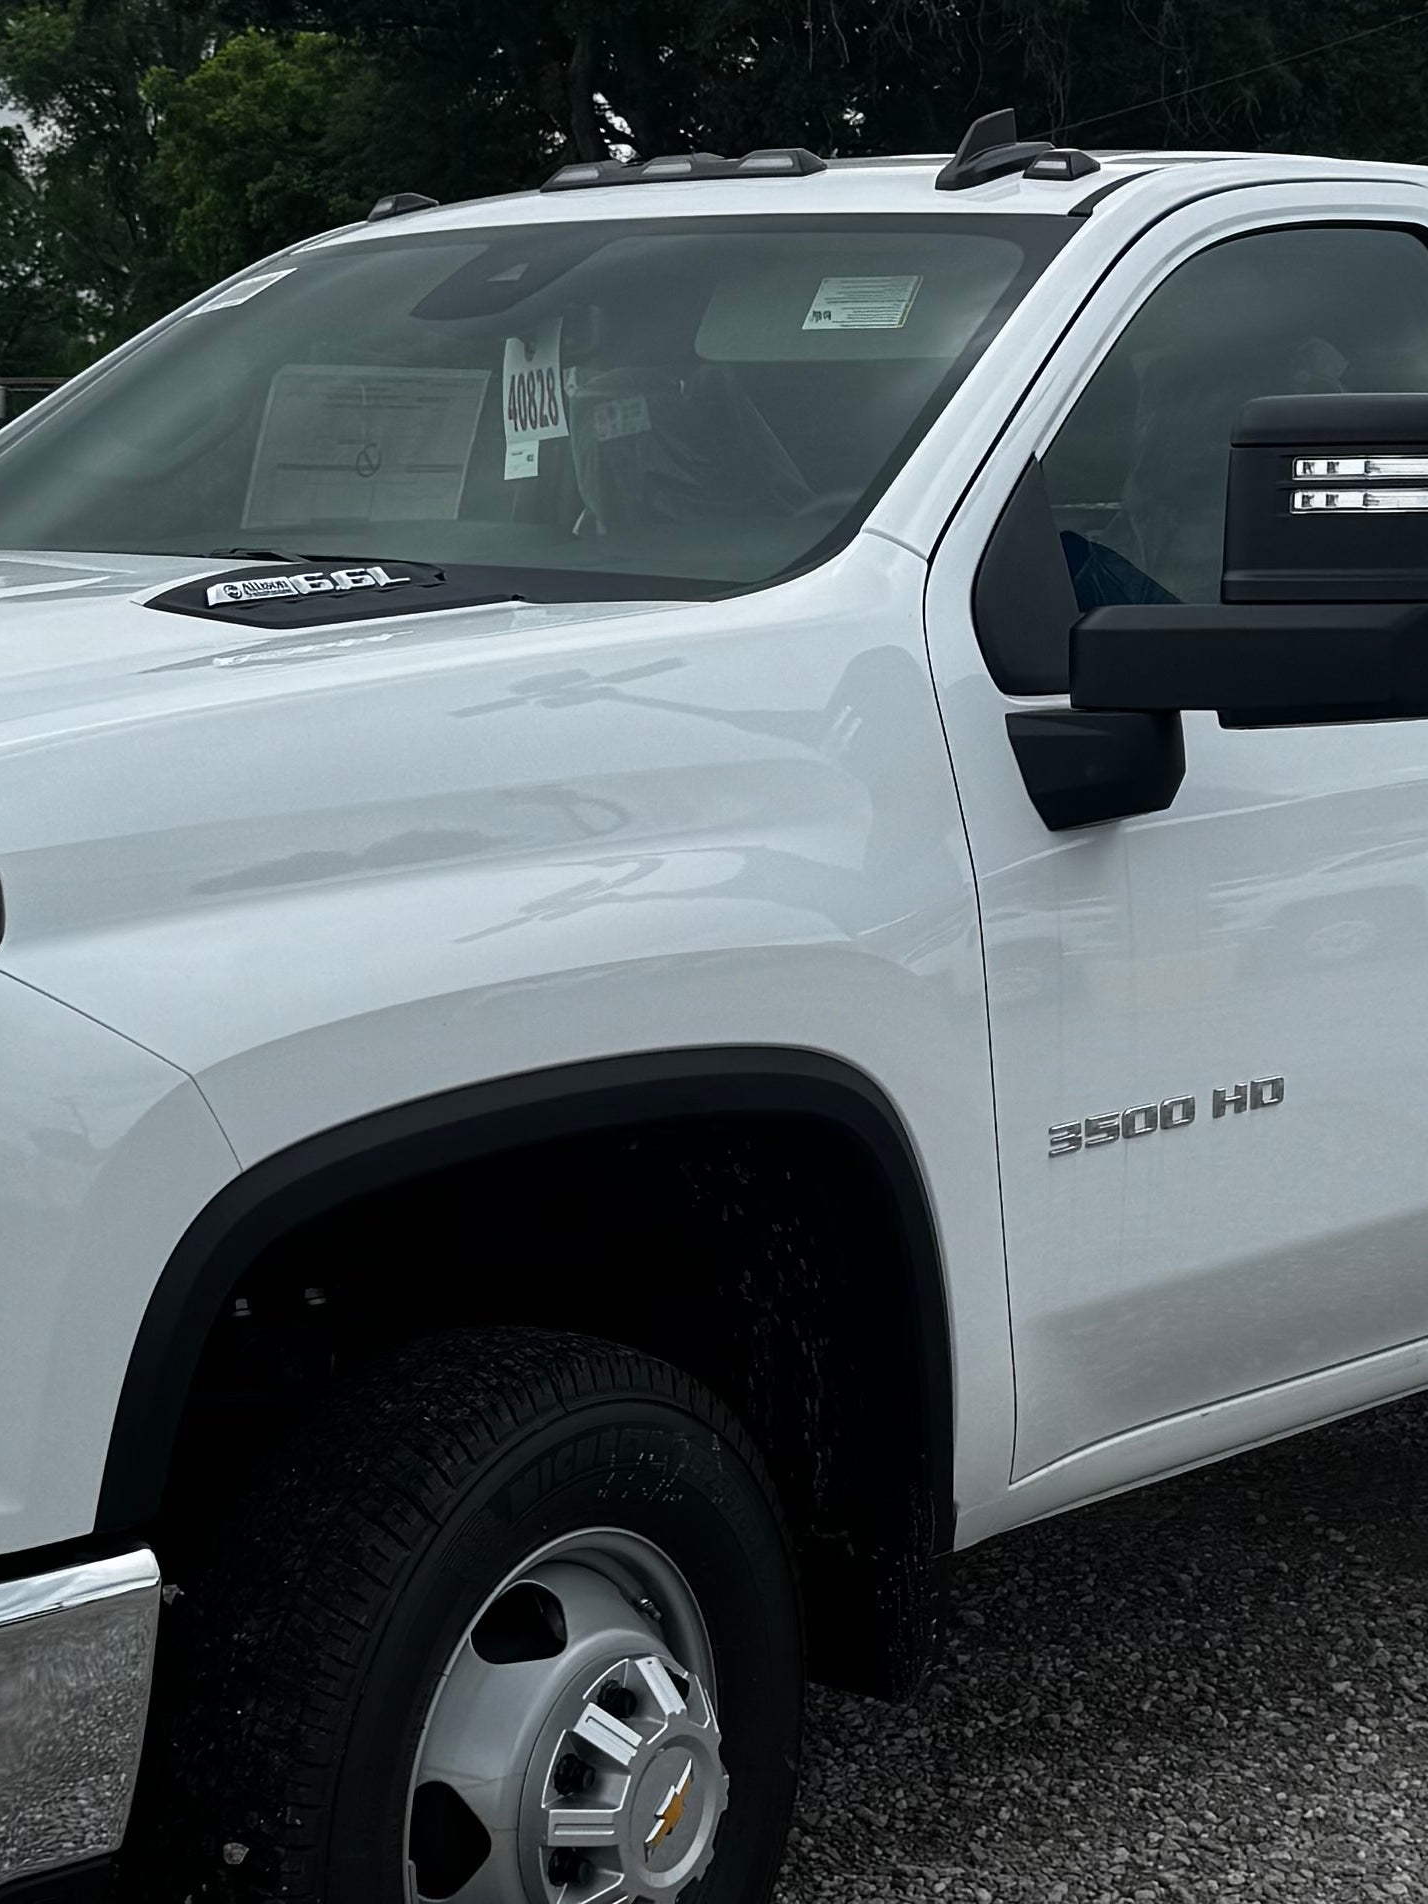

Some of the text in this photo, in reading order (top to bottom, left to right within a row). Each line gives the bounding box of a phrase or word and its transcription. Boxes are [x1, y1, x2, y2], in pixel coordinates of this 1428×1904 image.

[507, 366, 560, 434] 40828
[292, 566, 411, 594] 6.6L
[1047, 1075, 1285, 1159] 3500 HD
